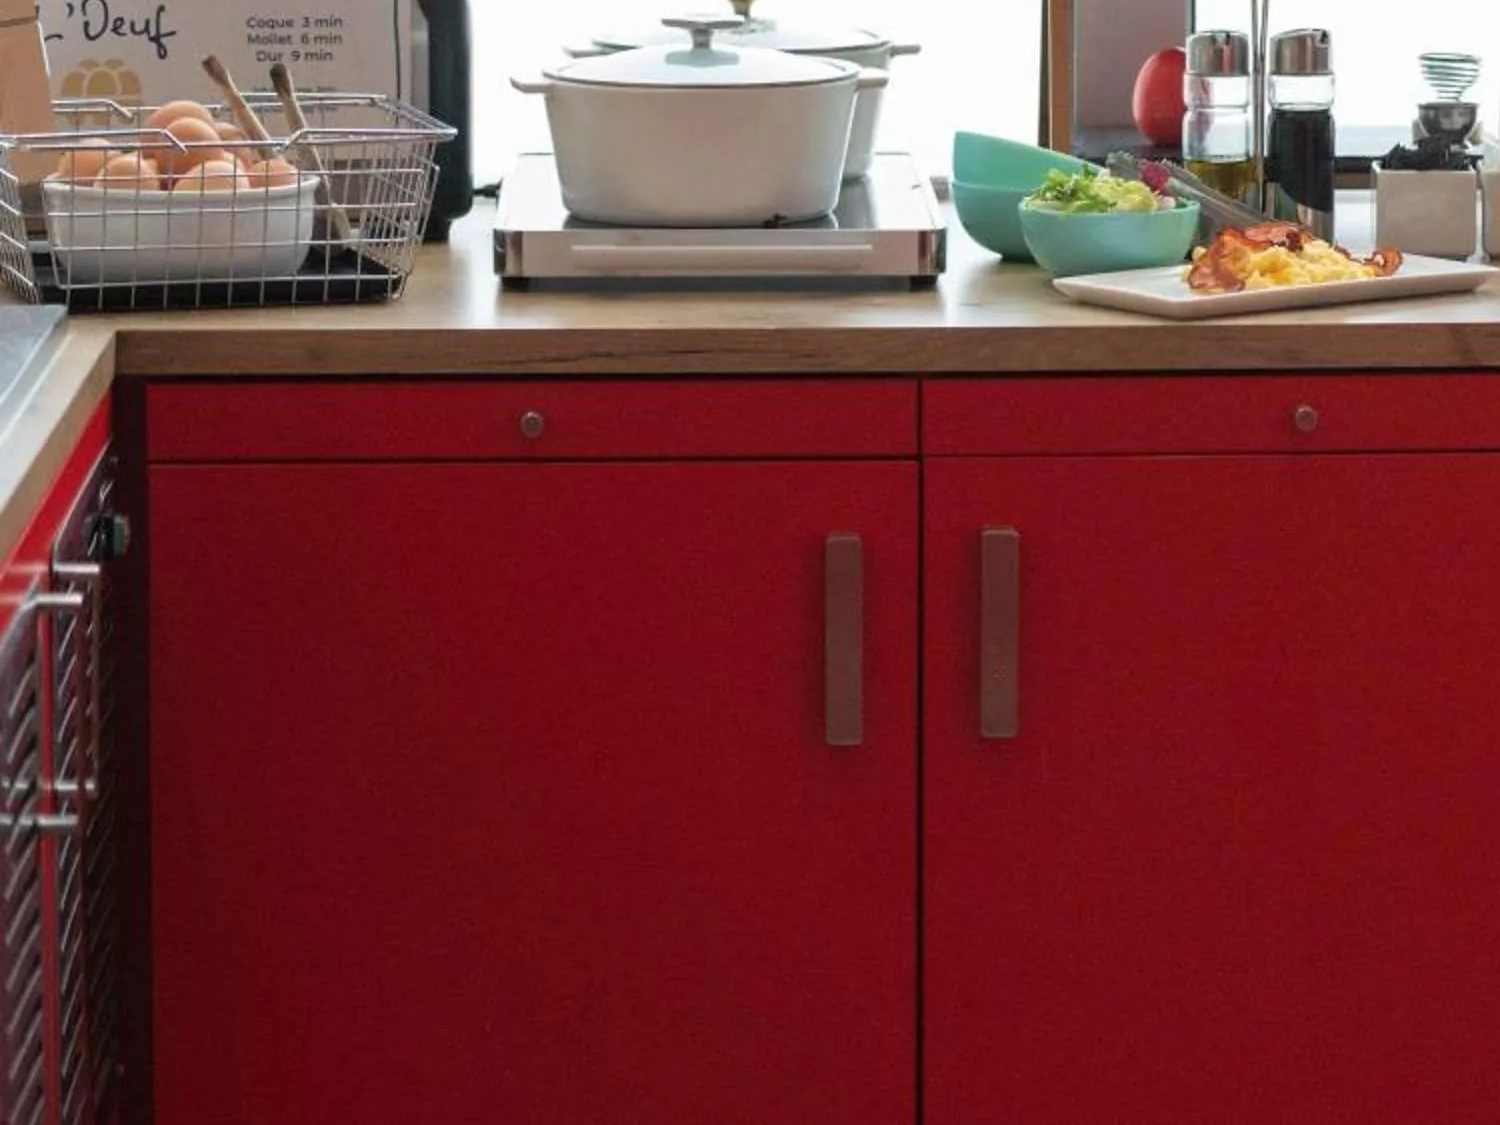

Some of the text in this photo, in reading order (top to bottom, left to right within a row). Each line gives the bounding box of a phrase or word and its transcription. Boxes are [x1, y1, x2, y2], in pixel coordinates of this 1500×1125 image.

[246, 14, 343, 29] Coque 3 min
[247, 31, 343, 45] Mollet 6 min
[256, 48, 333, 63] Dur 9 min
